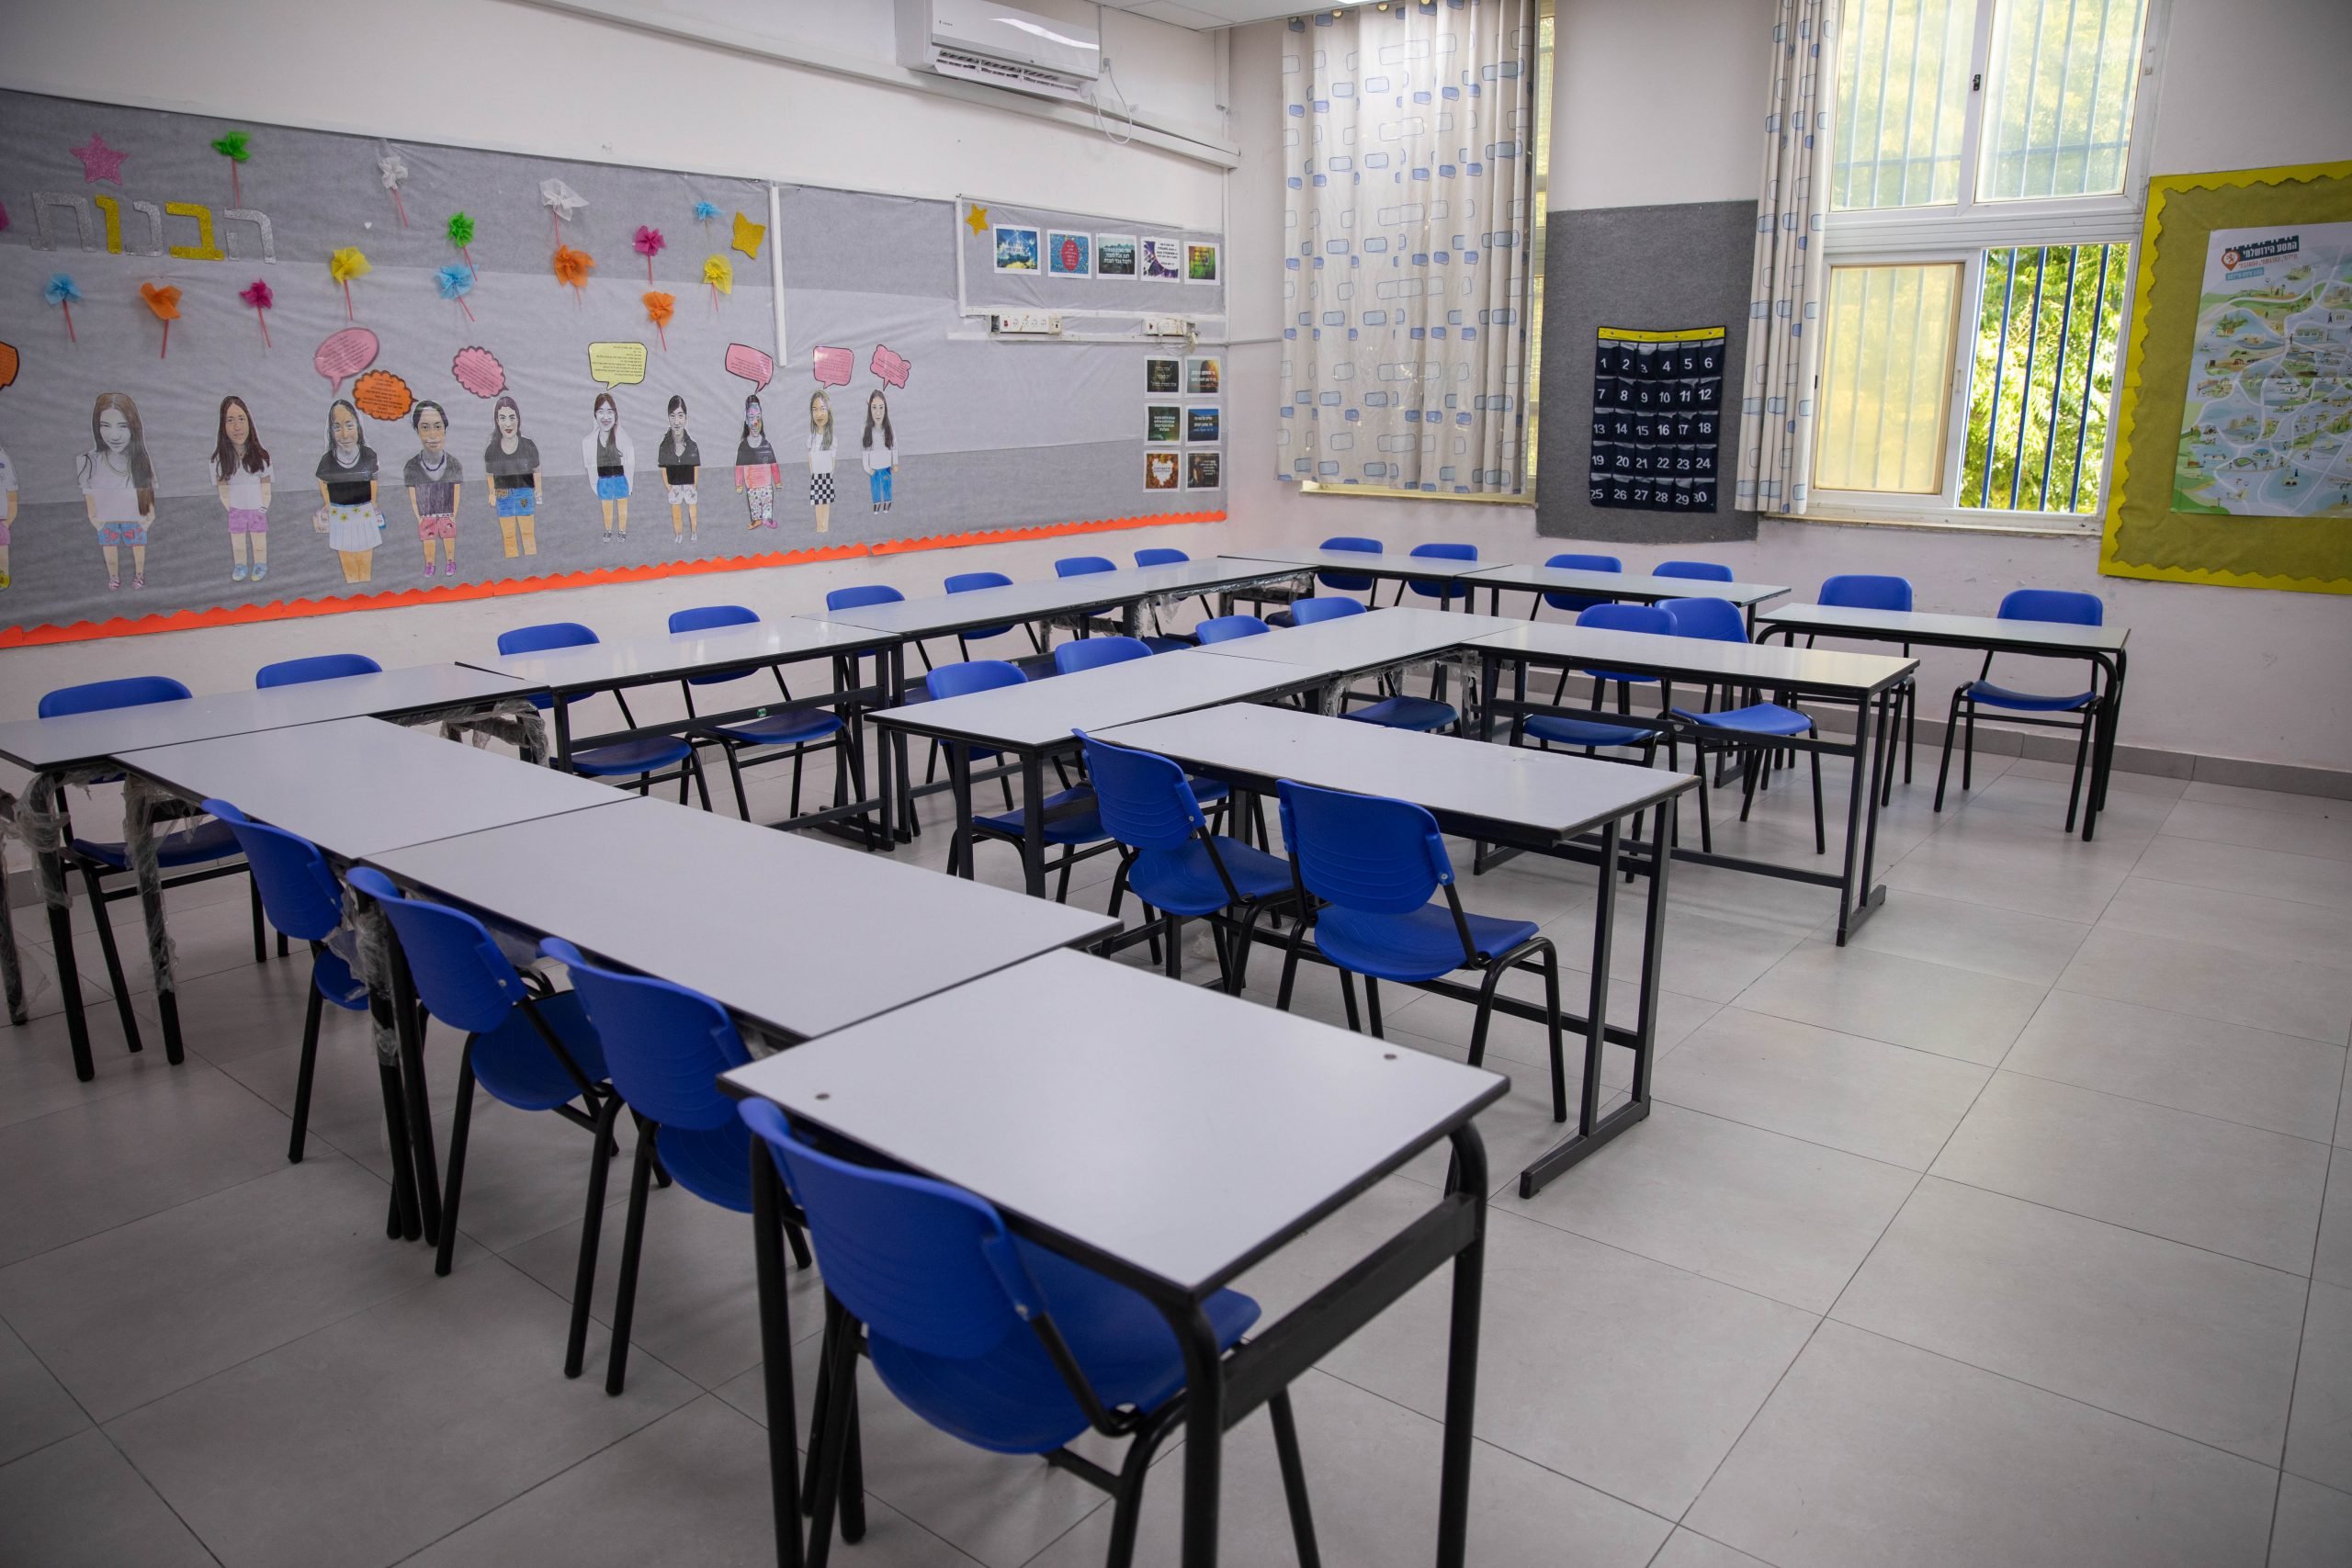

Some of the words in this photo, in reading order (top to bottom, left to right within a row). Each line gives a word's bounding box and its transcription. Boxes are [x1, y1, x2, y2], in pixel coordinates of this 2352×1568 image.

[29, 191, 276, 265] הבנות
[2243, 245, 2275, 258] הירושלמי
[2277, 242, 2297, 253] המסע
[1600, 358, 1607, 368] 1
[1623, 359, 1630, 370] 2
[1641, 365, 1648, 374] 3
[1663, 361, 1670, 371] 4
[1684, 358, 1692, 369] 5
[1704, 357, 1713, 368] 6
[1598, 389, 1605, 400] 7
[1620, 390, 1628, 401] 8
[1641, 392, 1648, 402] 9
[1659, 392, 1670, 402] 10
[1679, 390, 1690, 401] 11
[1699, 389, 1712, 400] 12
[1593, 424, 1605, 434] 13
[1615, 423, 1628, 434] 14
[1636, 425, 1649, 436] 15
[1657, 424, 1670, 435] 16
[1679, 424, 1689, 434] 17
[1699, 423, 1712, 434] 18
[1592, 456, 1604, 465] 19
[1616, 456, 1630, 468] 20
[1636, 457, 1648, 468] 21
[1657, 457, 1669, 468] 22
[1677, 458, 1690, 469] 23
[1696, 457, 1711, 468] 24
[1590, 489, 1603, 500] 25
[1613, 489, 1627, 501] 26
[1634, 490, 1648, 501] 27
[1656, 491, 1668, 502] 28
[1676, 493, 1690, 504] 29
[1693, 491, 1707, 502] 30
